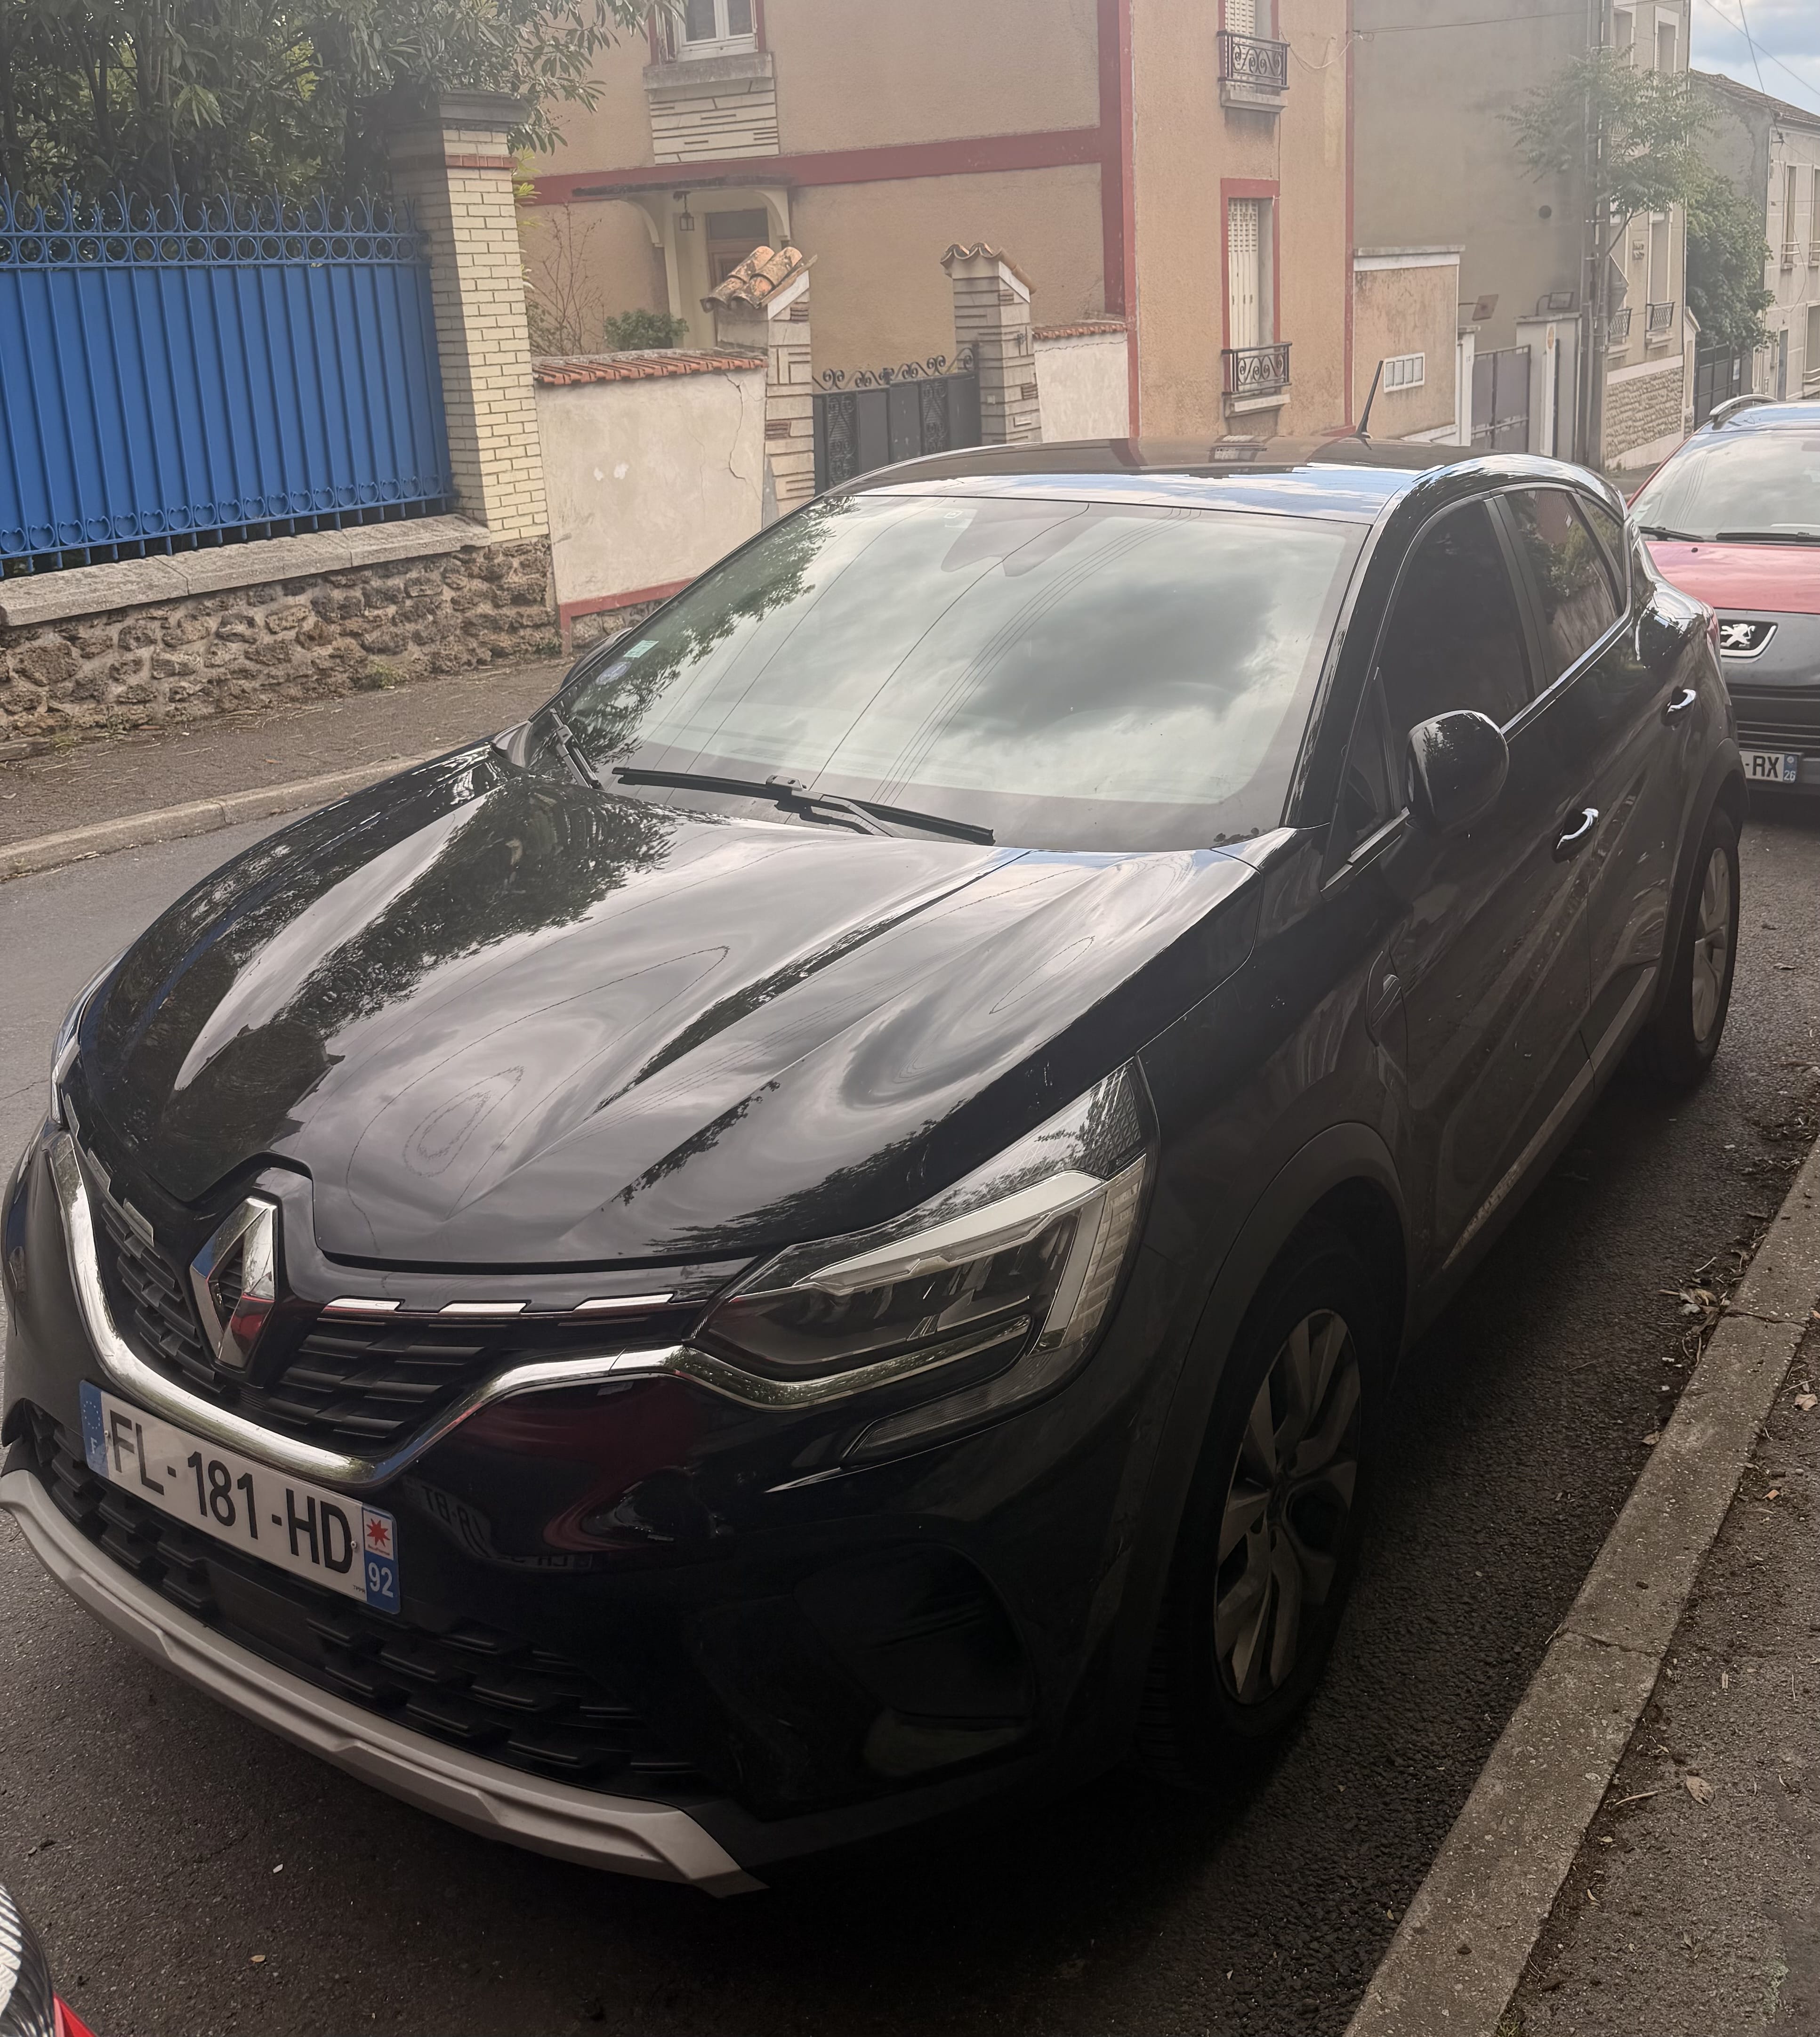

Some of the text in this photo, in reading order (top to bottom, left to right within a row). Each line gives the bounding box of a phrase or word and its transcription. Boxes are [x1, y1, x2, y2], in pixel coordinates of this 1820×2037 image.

[1784, 770, 1796, 781] 26
[91, 1437, 97, 1454] F
[110, 1410, 352, 1574] FL-181-HD
[368, 1562, 394, 1598] 92
